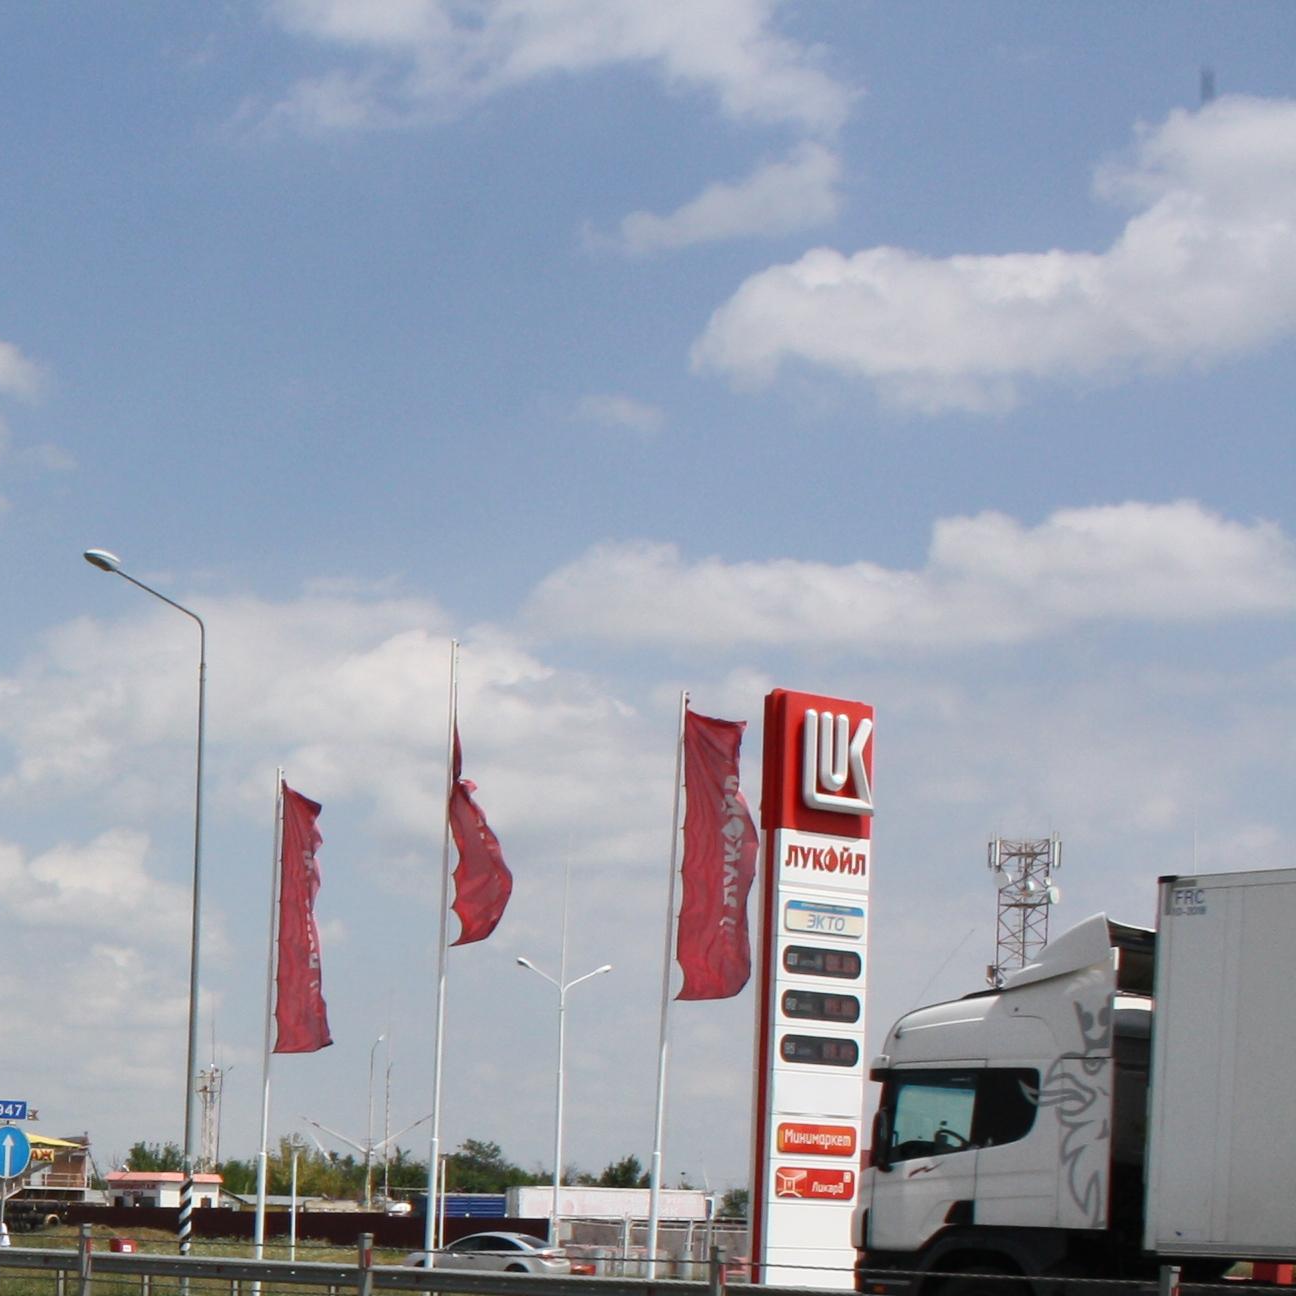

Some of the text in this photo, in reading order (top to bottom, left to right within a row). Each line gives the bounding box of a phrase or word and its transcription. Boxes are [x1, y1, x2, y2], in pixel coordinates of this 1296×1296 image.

[785, 844, 866, 876] ЛУКОЙЛ
[1175, 889, 1205, 906] FRC
[806, 914, 846, 931] ЭКТО
[784, 1128, 851, 1149] Минимаркет
